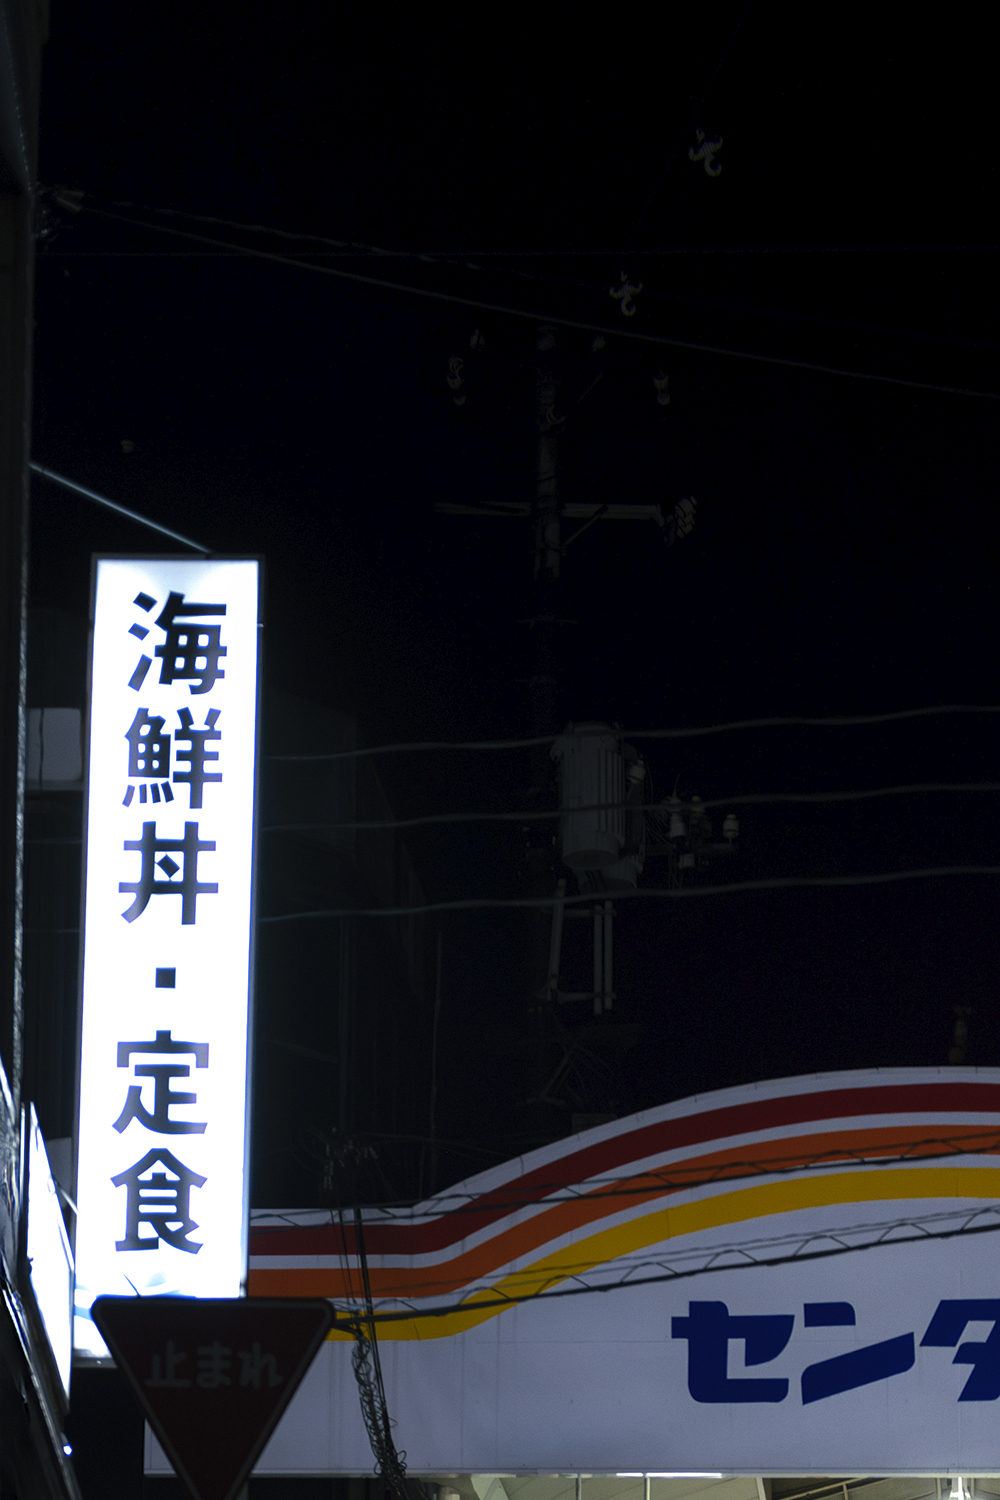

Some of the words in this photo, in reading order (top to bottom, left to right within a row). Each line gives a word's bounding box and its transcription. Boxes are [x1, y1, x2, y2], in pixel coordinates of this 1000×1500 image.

[110, 590, 228, 1256] 海鮮丼・定食
[145, 1340, 284, 1389] 止まれ
